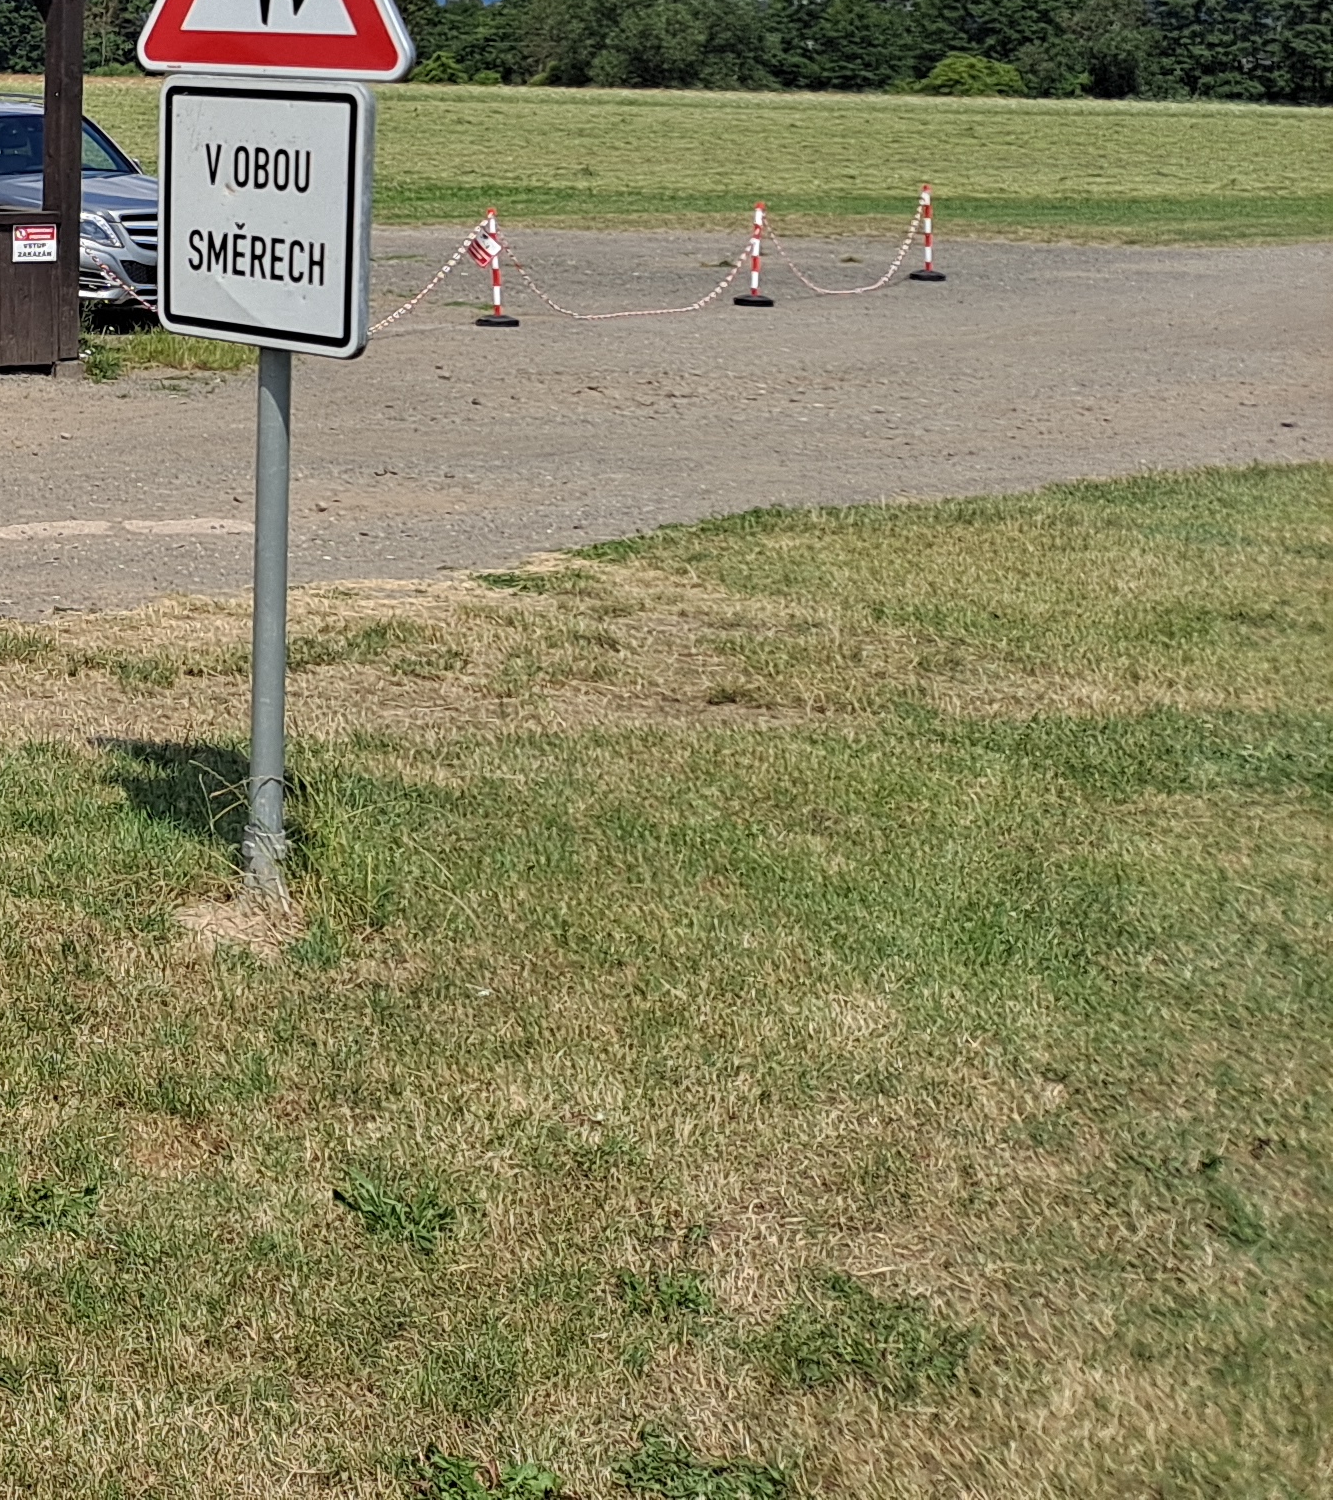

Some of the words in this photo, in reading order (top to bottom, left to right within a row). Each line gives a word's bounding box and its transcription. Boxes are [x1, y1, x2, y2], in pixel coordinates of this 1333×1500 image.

[205, 142, 222, 186] V
[233, 145, 312, 194] OBOU
[187, 221, 326, 287] SMĚRECH
